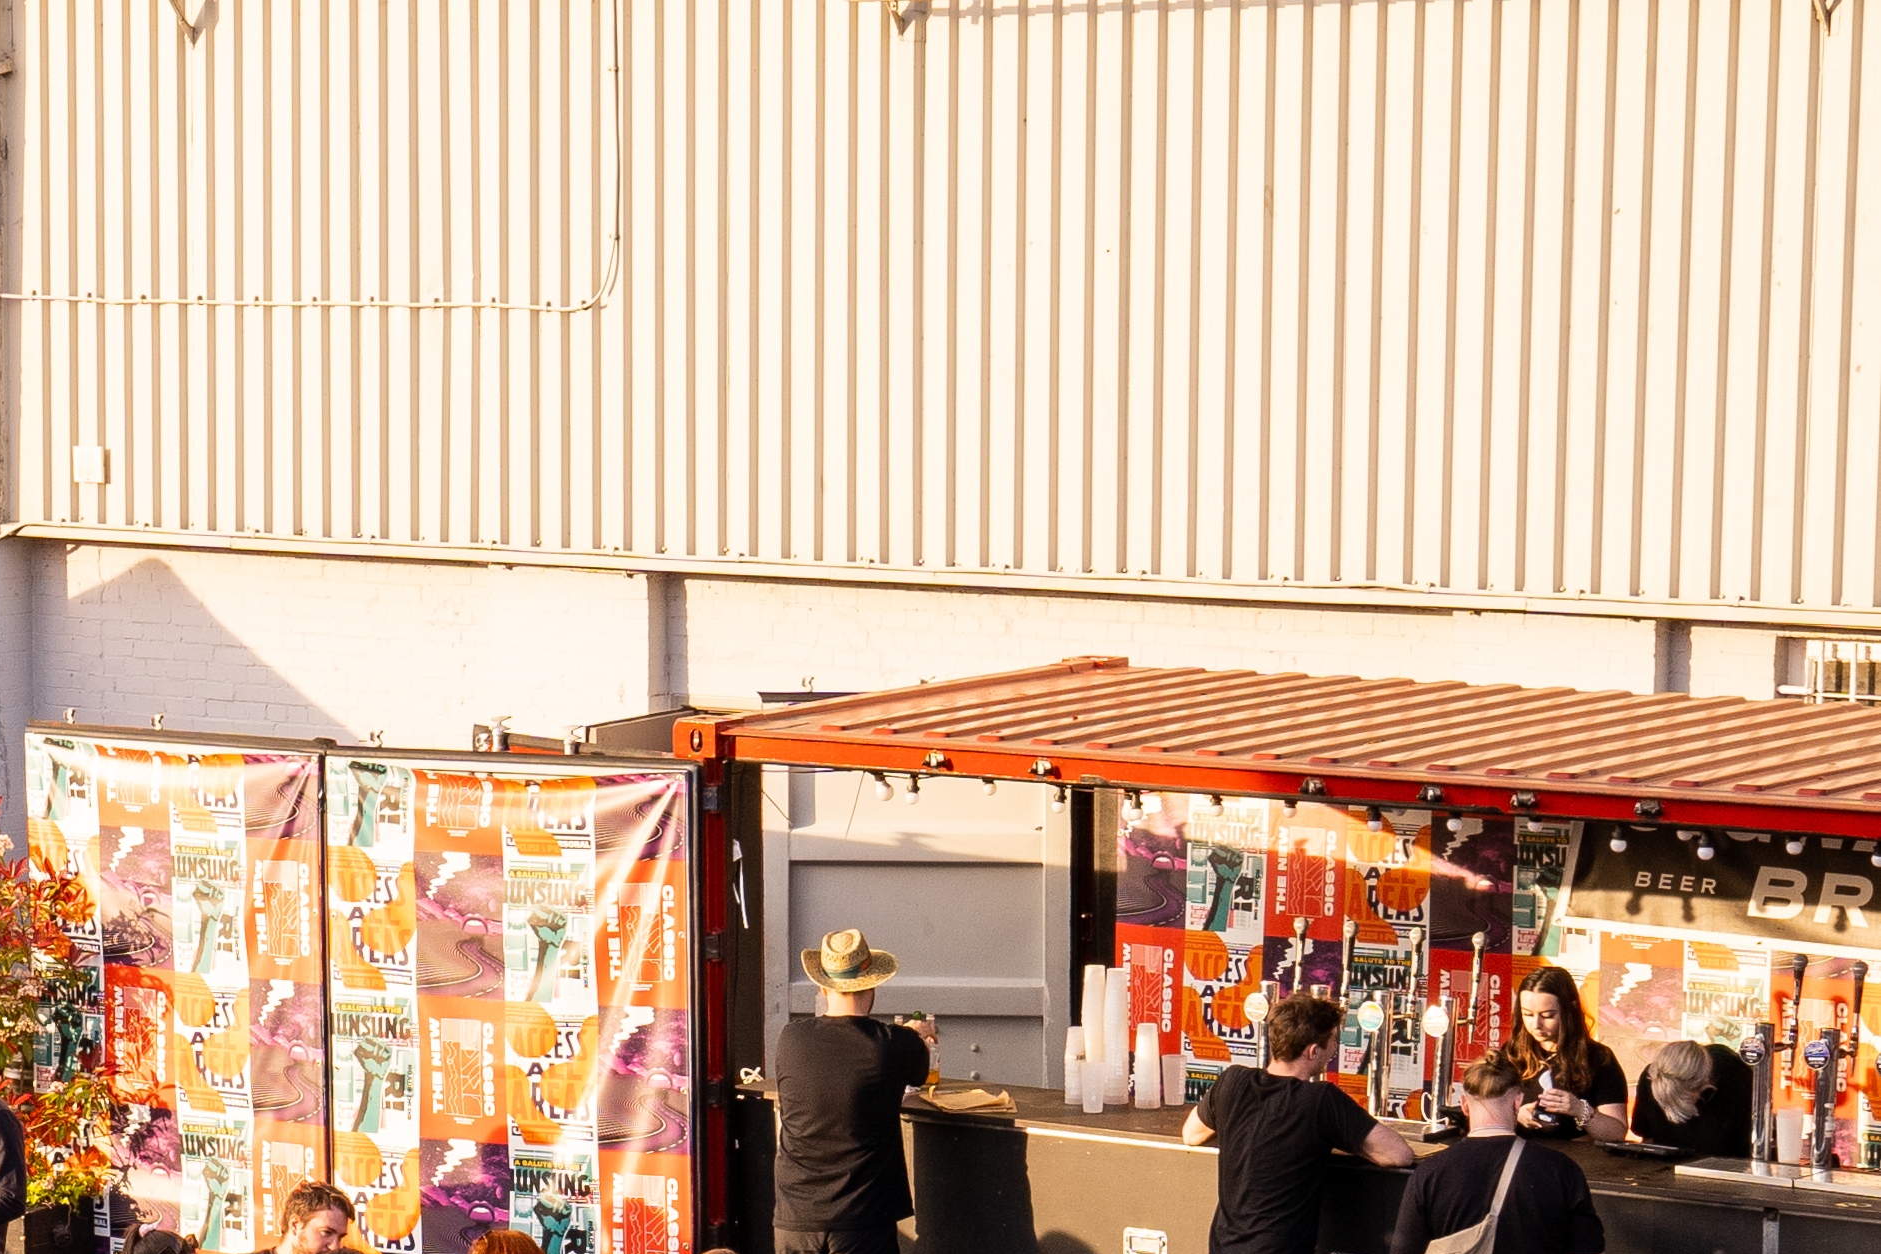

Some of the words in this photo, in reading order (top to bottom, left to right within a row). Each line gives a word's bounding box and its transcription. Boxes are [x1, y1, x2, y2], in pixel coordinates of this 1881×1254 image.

[1277, 826, 1289, 872] NEW
[1519, 845, 1567, 867] UNSU
[1526, 836, 1554, 844] SALUTE
[177, 855, 239, 881] UNSUNG
[253, 859, 265, 908] NEW
[1324, 830, 1337, 918] CLASSIC
[1635, 871, 1716, 894] BEER
[298, 863, 310, 957] CLASSIC
[510, 881, 586, 906] UNSUNG
[1275, 876, 1288, 915] THE
[1747, 866, 1874, 928] BR
[254, 913, 268, 955] THE
[662, 884, 675, 981] CLASSIC
[607, 942, 620, 981] THE
[1189, 954, 1254, 987] ACCESS
[1351, 964, 1409, 990] UNSUN
[1162, 948, 1175, 1033] CLASSIC
[336, 1013, 410, 1040] UNSUNG
[1489, 974, 1501, 1051] CLASSI
[429, 1017, 441, 1063] NEW
[513, 1025, 588, 1062] ACCESS
[1836, 1002, 1848, 1093] CLASIC
[483, 1022, 495, 1117] CLASSIC
[432, 1073, 444, 1114] THE
[510, 1078, 591, 1123] AREAS
[185, 1134, 245, 1160] UNSUNG
[262, 1140, 272, 1188] NEW
[522, 1160, 551, 1168] SALUTE
[341, 1155, 409, 1192] ACCESS
[516, 1169, 590, 1197] UNSUNG
[263, 1194, 274, 1235] THE
[612, 1172, 625, 1224] NEW
